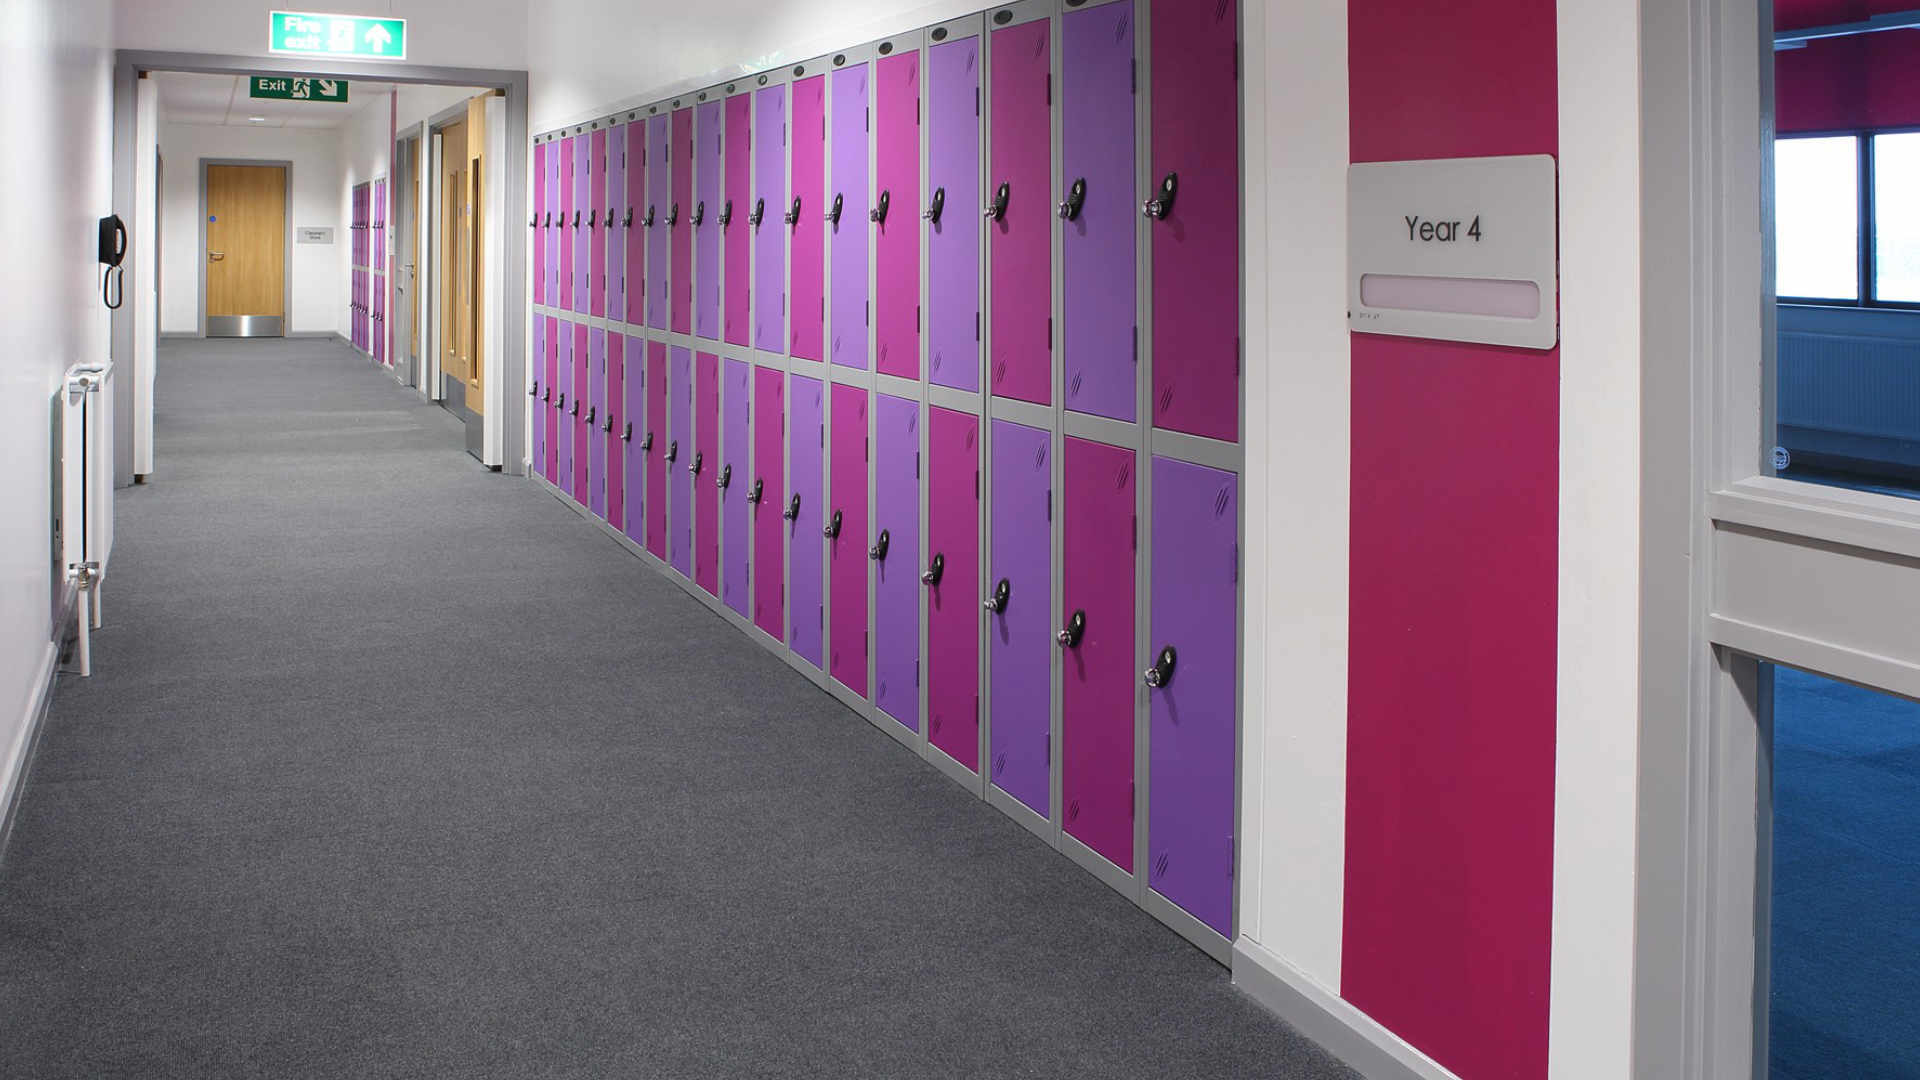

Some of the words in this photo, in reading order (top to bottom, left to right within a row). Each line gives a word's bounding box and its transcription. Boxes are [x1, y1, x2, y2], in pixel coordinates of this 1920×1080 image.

[284, 17, 321, 33] Fire
[285, 34, 320, 50] exit
[258, 79, 286, 91] Exit
[1405, 215, 1460, 242] Year
[1467, 215, 1482, 242] 4
